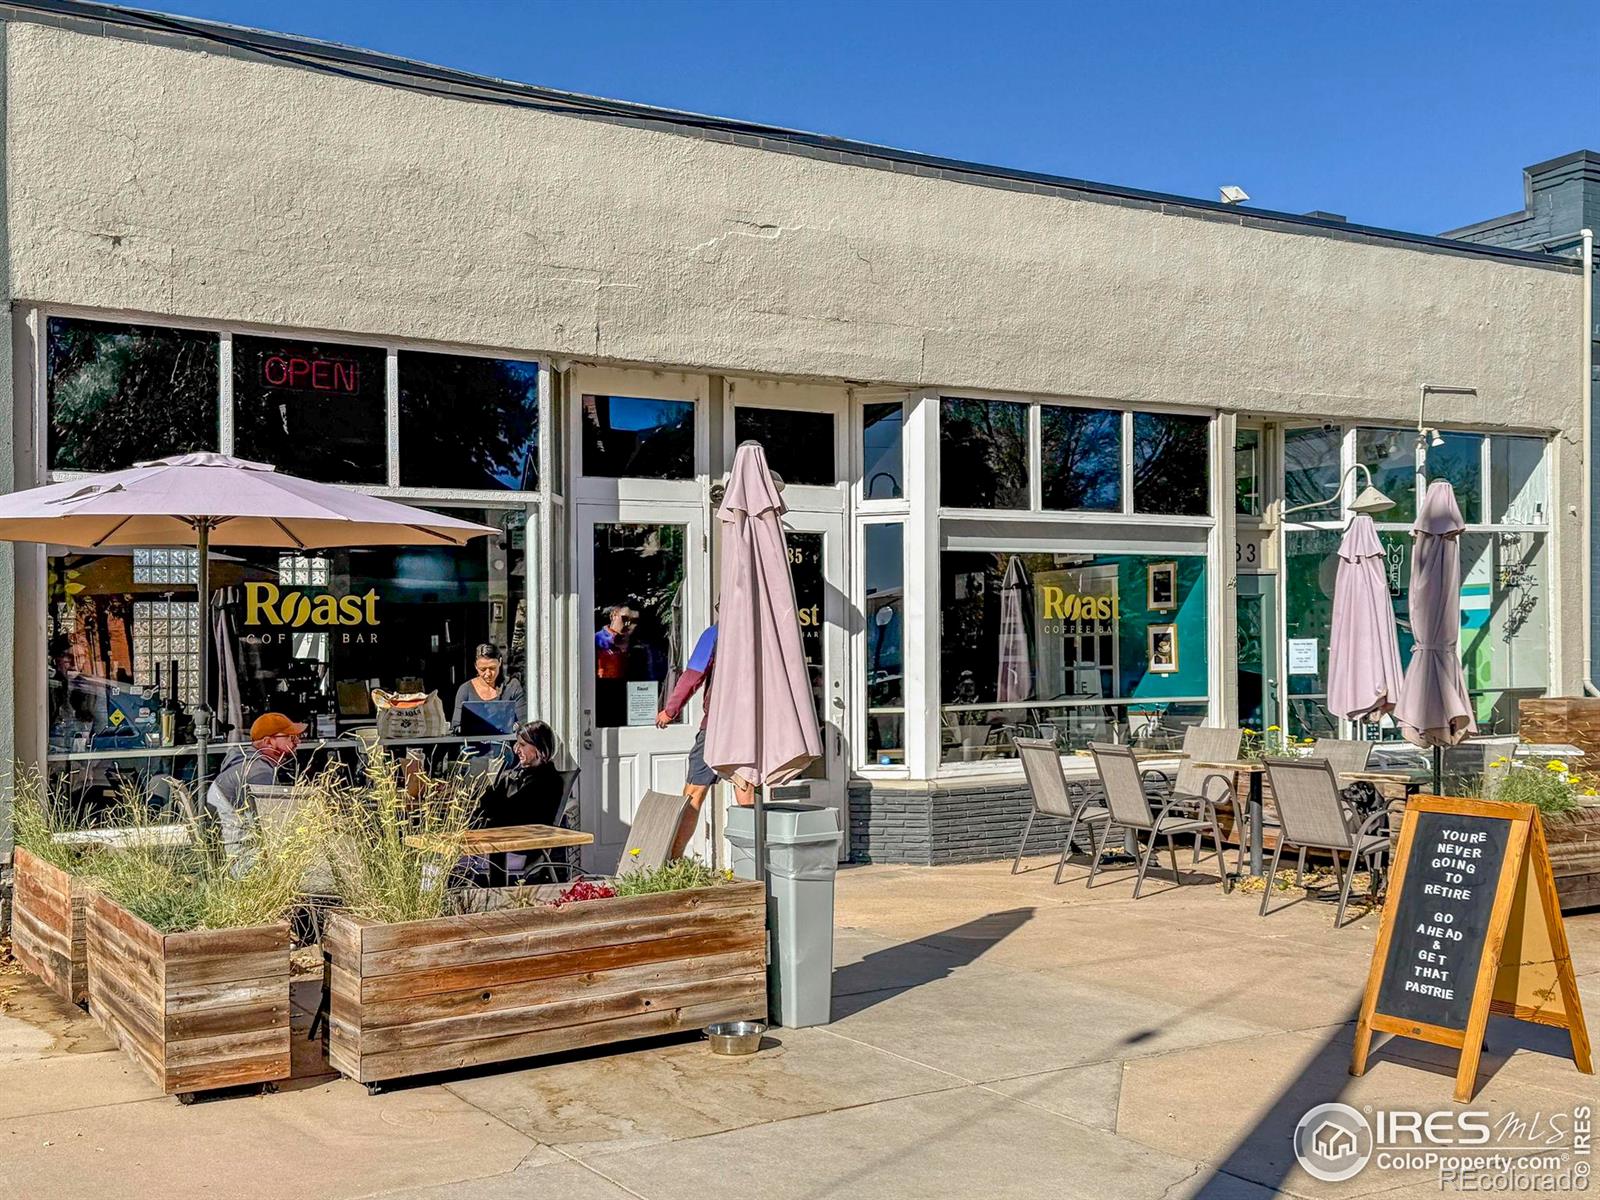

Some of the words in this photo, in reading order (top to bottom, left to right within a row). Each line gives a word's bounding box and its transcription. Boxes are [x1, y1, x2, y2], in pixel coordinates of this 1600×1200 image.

[264, 356, 354, 391] OPEN
[244, 581, 381, 627] Roast
[1043, 586, 1121, 621] Roast
[802, 631, 819, 639] AR
[1044, 625, 1091, 634] COFFEE
[1099, 625, 1119, 635] BA
[246, 633, 330, 645] COFEE
[342, 633, 378, 644] BAR
[1442, 829, 1488, 844] YOURE
[1437, 843, 1482, 858] NEVER
[1431, 857, 1476, 874] GOING
[1445, 872, 1463, 884] TO
[1424, 884, 1472, 900] RETIRE
[1434, 912, 1454, 924] GO
[1416, 923, 1463, 941] AHEAD
[1432, 940, 1441, 950] &
[1418, 949, 1447, 965] GET
[1414, 965, 1449, 982] THAT
[1405, 980, 1454, 1000] PASTRIE
